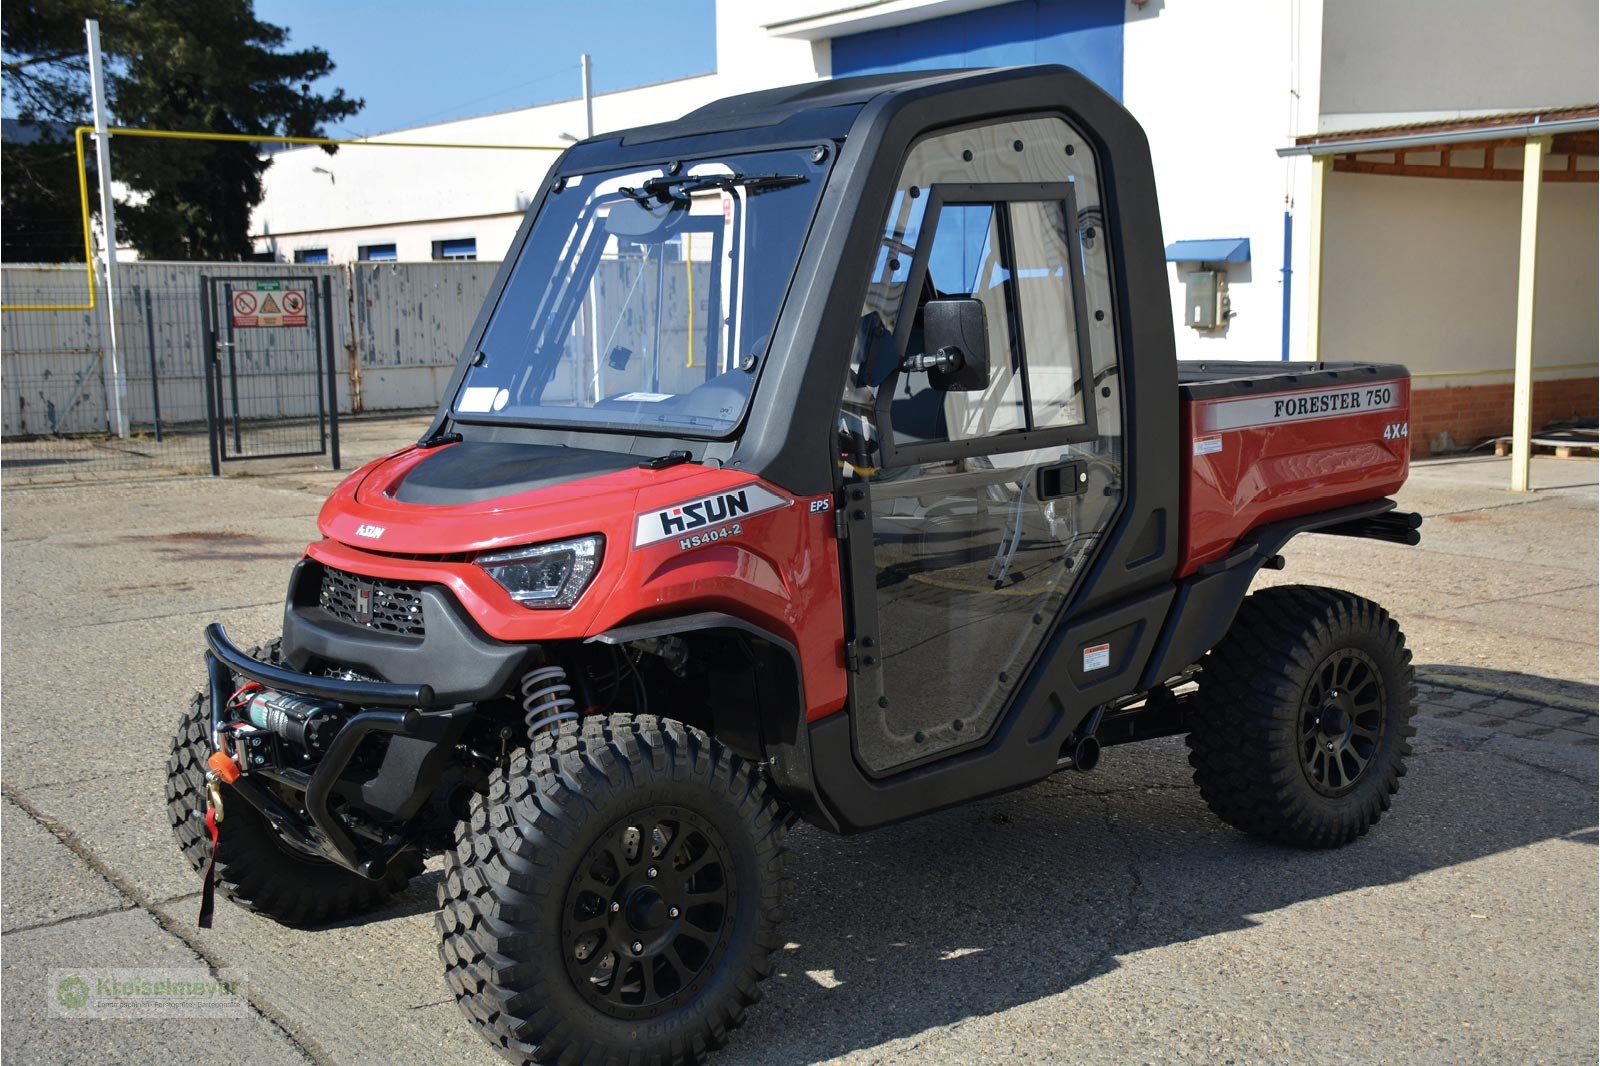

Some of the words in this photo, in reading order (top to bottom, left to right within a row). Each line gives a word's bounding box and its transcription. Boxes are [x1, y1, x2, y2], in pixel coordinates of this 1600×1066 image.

[1274, 391, 1361, 417] FORESTER
[1366, 388, 1391, 406] 750
[1383, 422, 1408, 440] 4X4
[810, 499, 829, 512] EPS
[680, 523, 742, 550] HS404-2
